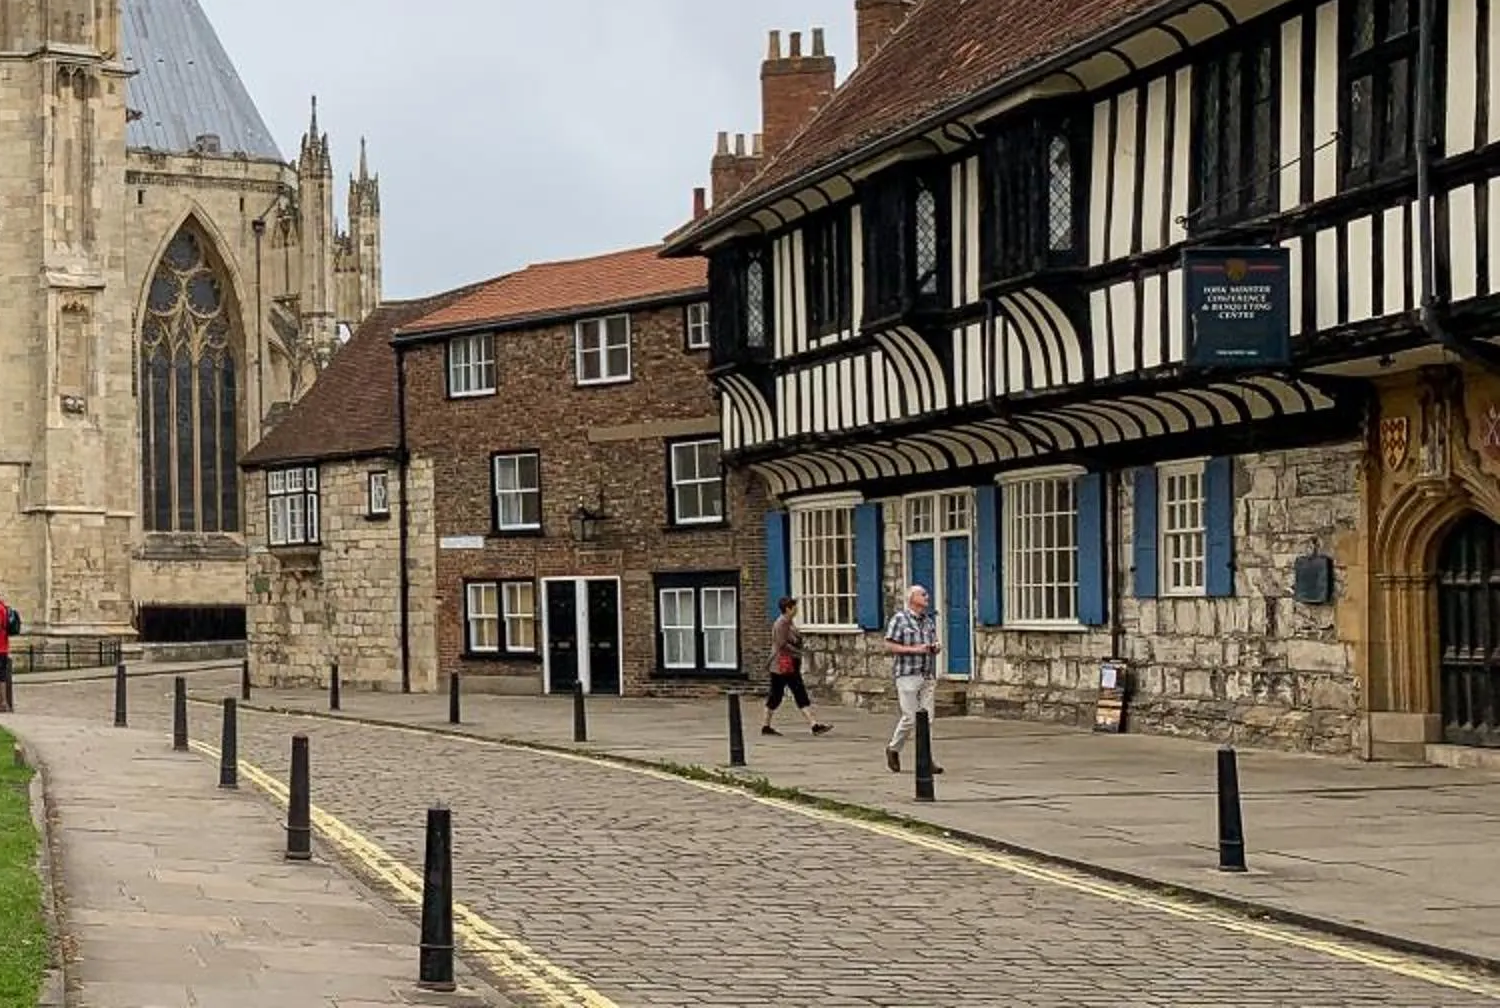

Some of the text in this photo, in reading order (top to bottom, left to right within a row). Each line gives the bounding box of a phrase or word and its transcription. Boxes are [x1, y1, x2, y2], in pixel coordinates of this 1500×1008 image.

[1204, 285, 1271, 293] YORK MINSTER
[1207, 294, 1267, 302] CONFERENCE
[1201, 303, 1272, 311] & BANQUETING
[1218, 311, 1255, 319] CENTRE
